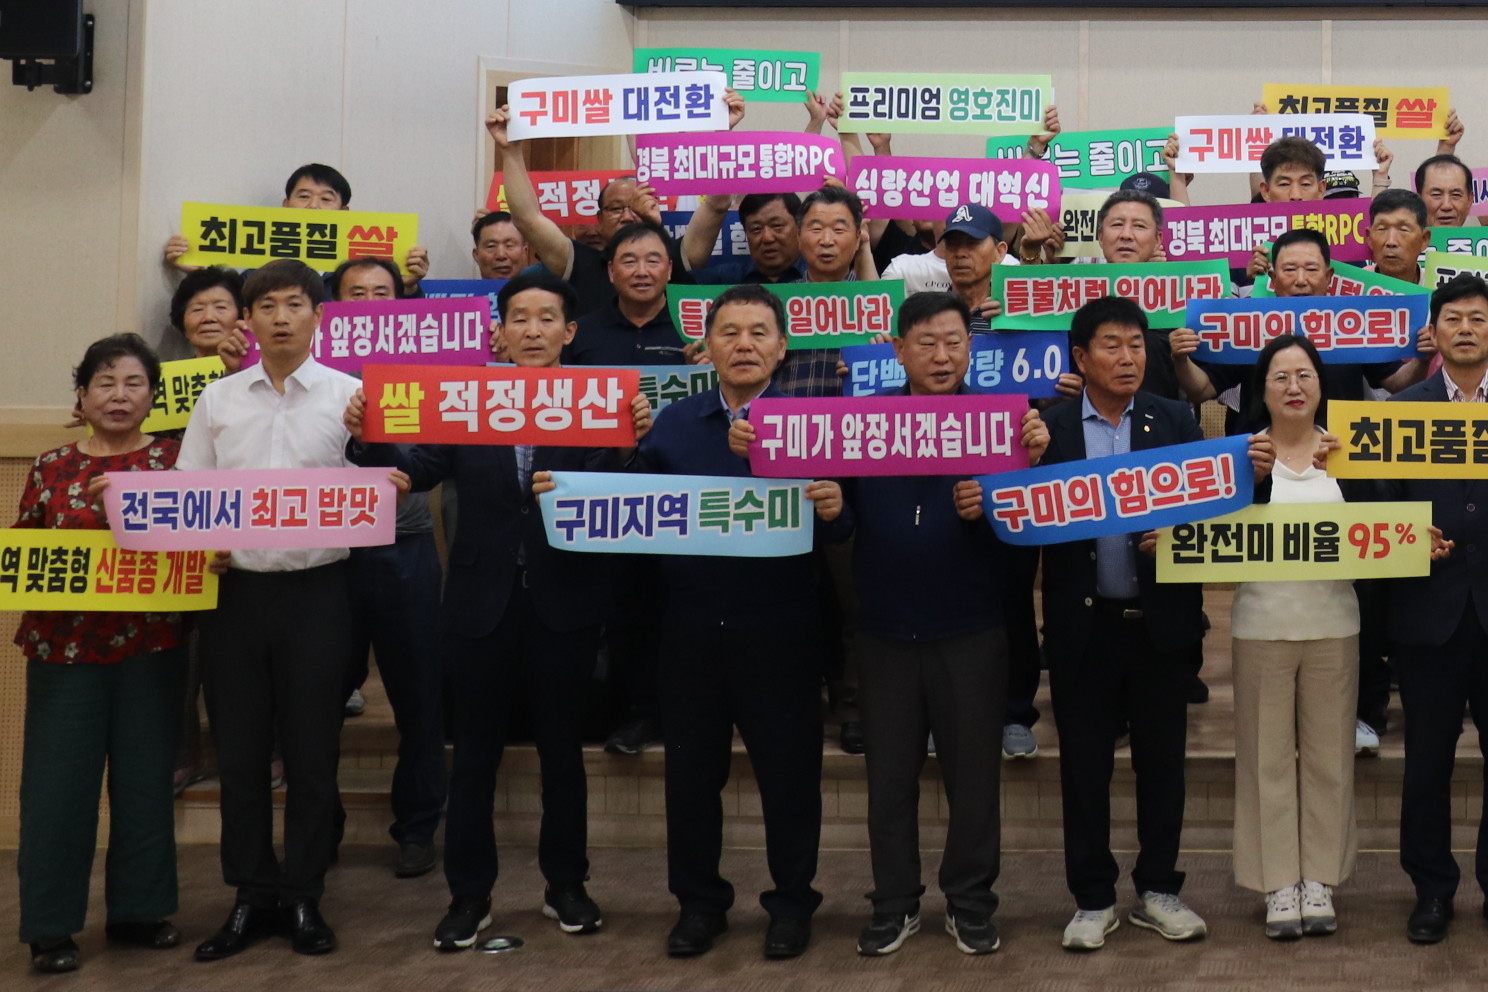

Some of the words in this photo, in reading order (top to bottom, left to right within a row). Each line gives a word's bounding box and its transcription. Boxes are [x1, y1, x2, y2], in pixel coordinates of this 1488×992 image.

[731, 57, 809, 93] 줄이고
[519, 87, 613, 126] 구미쌀
[622, 83, 714, 122] 대전환
[847, 85, 941, 122] 프리미엄
[948, 86, 1042, 123] 영호진미
[1394, 97, 1437, 130] 쌀
[636, 146, 670, 183] 경북
[673, 143, 757, 181] 최대규모
[759, 143, 837, 179] 통합RPC
[1088, 139, 1170, 177] 줄이고
[1188, 126, 1273, 163] 구미쌀
[855, 167, 960, 209] 식량산업
[968, 170, 1050, 210] 대혁신
[197, 216, 338, 261] 최고품질
[347, 224, 399, 262] 쌀
[1167, 220, 1206, 257] 경북
[329, 311, 484, 359] 앞장서겠습니다
[788, 294, 892, 334] 일어나라
[1201, 313, 1292, 351] 구미의
[1302, 309, 1409, 350] 힘으로!
[1011, 344, 1063, 384] 6.0
[379, 382, 425, 434] 쌀
[438, 376, 624, 433] 적정생산
[761, 413, 834, 461] 구미가
[840, 411, 1014, 459] 앞장서겠습니다
[121, 489, 241, 532] 전국에서
[251, 487, 309, 528] 최고
[318, 486, 379, 528] 밥맛
[995, 475, 1103, 531] 구미의
[1110, 454, 1236, 517] 힘으로!
[555, 492, 689, 543] 구미지역
[698, 486, 800, 535] 특수미
[1171, 521, 1274, 565] 완전미
[1283, 520, 1341, 564] 비율
[1347, 522, 1417, 561] 95%
[27, 546, 91, 595] 맞춤형
[95, 547, 159, 596] 신품종
[162, 550, 207, 596] 개발
